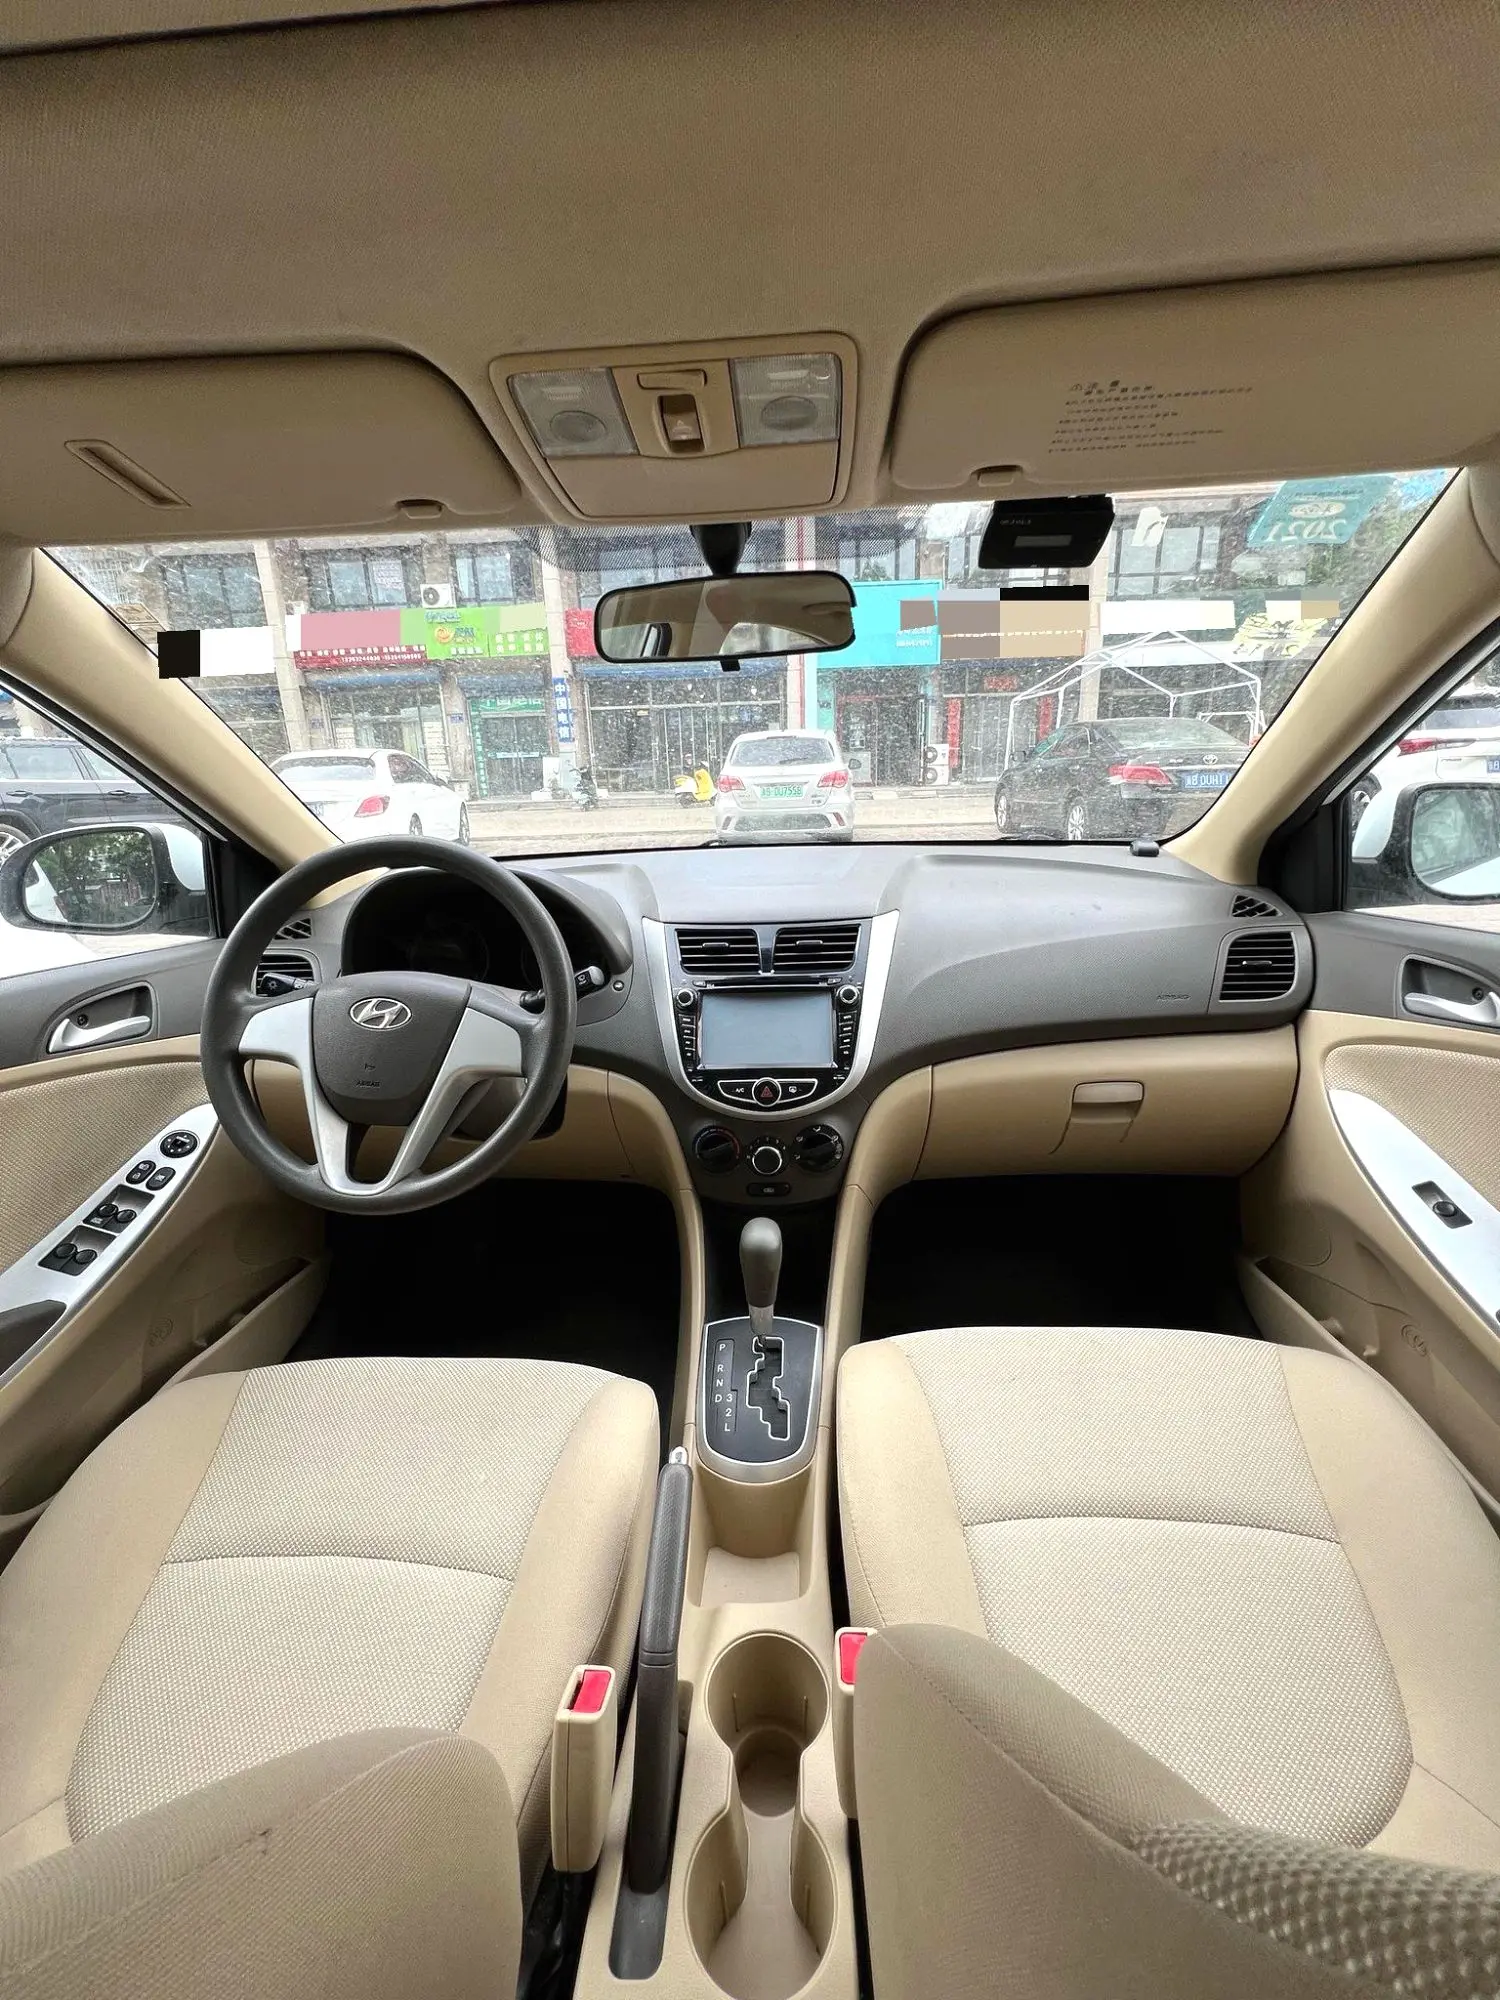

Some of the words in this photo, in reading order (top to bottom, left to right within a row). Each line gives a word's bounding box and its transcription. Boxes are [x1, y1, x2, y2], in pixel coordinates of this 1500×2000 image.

[555, 683, 570, 739] 中国电信
[719, 1343, 727, 1352] P
[717, 1364, 724, 1372] R
[716, 1379, 724, 1387] N
[714, 1394, 722, 1403] D
[726, 1393, 733, 1402] 3
[725, 1408, 732, 1417] 2
[724, 1423, 731, 1432] L
